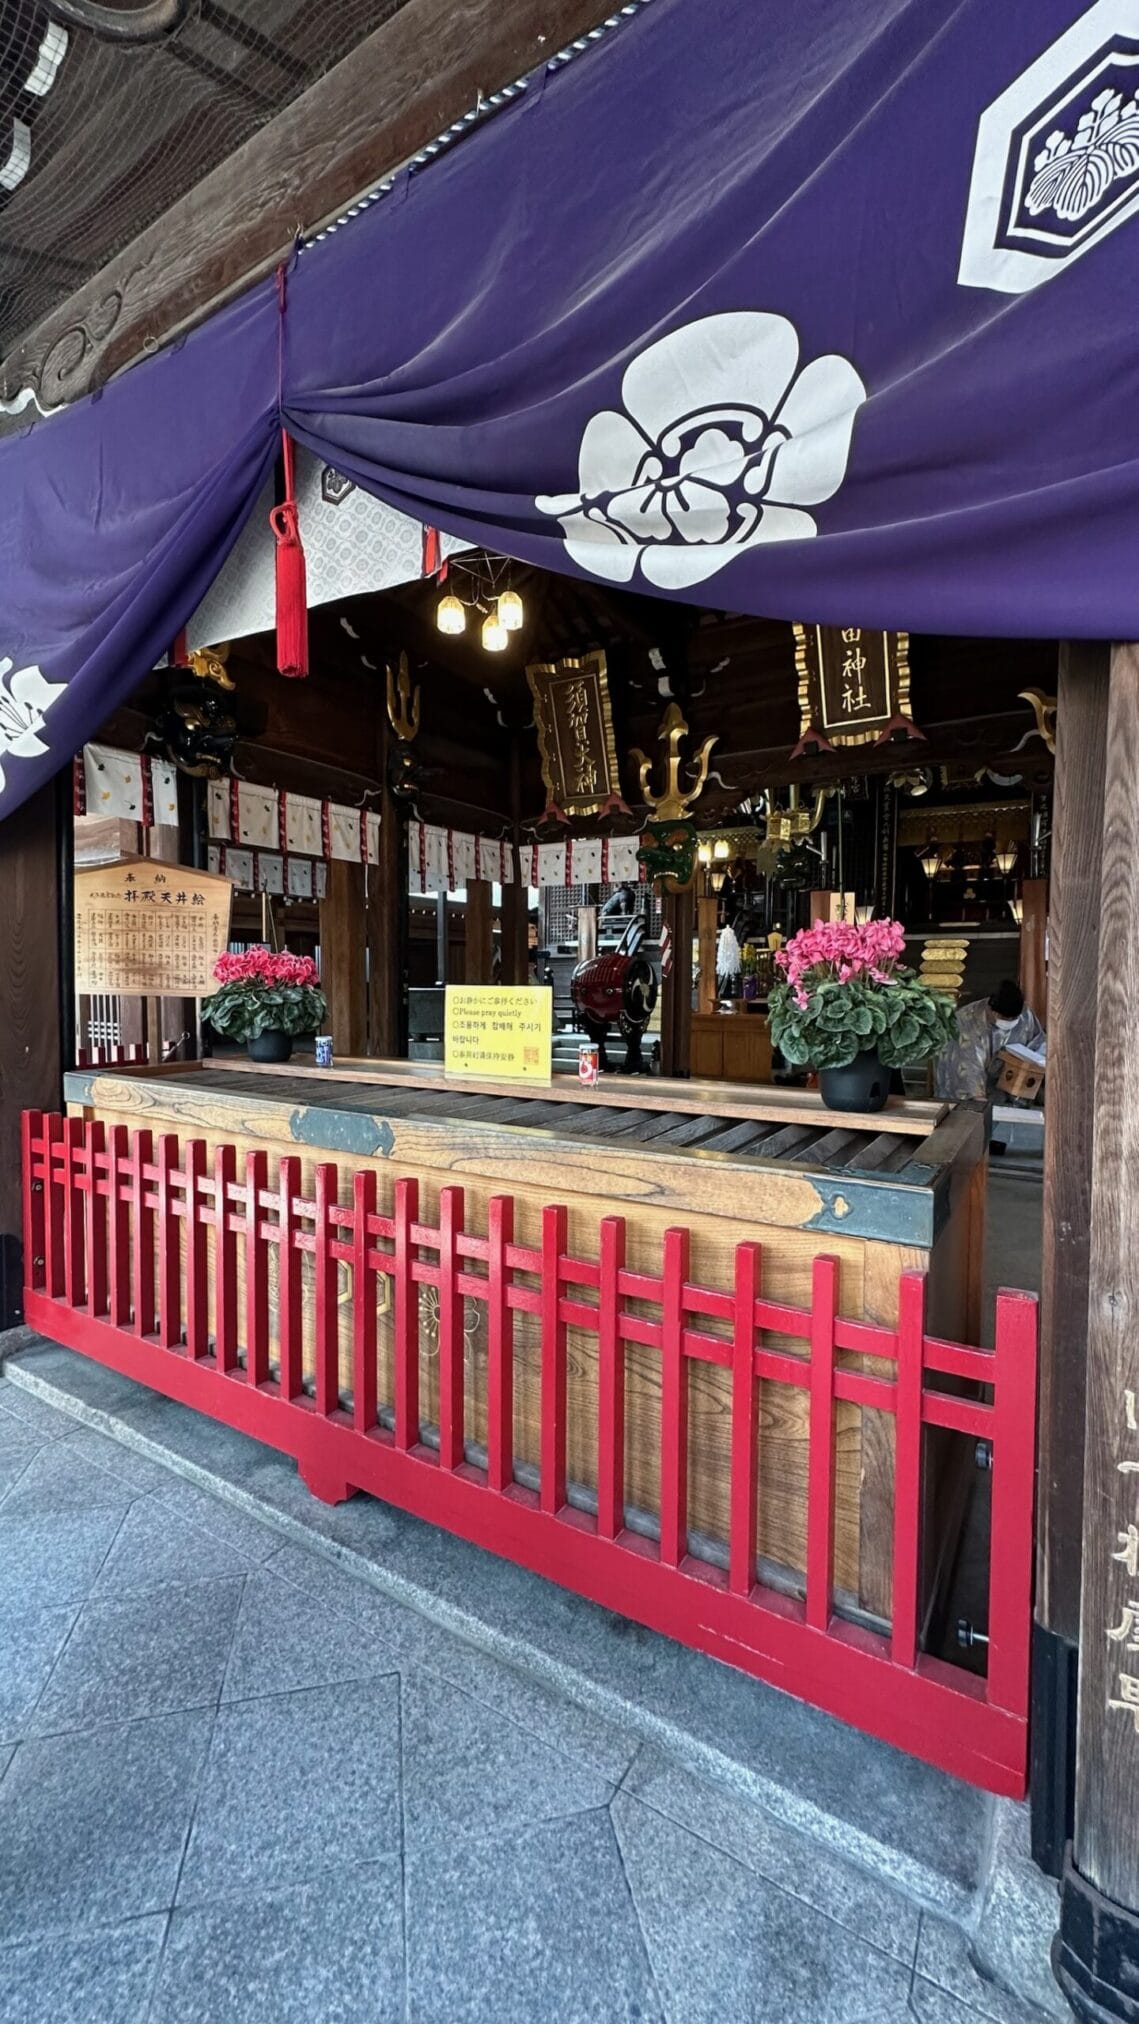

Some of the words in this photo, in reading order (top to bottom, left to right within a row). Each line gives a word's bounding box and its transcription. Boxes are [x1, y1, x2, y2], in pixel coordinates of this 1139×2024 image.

[564, 680, 599, 794] 須賀大神
[124, 889, 206, 906] 拝殿天井絵
[459, 1008, 480, 1016] Please
[481, 1010, 497, 1018] pray
[497, 1009, 522, 1018] quietly
[519, 1023, 542, 1032] 주시기
[452, 1035, 480, 1045] 바랍니다
